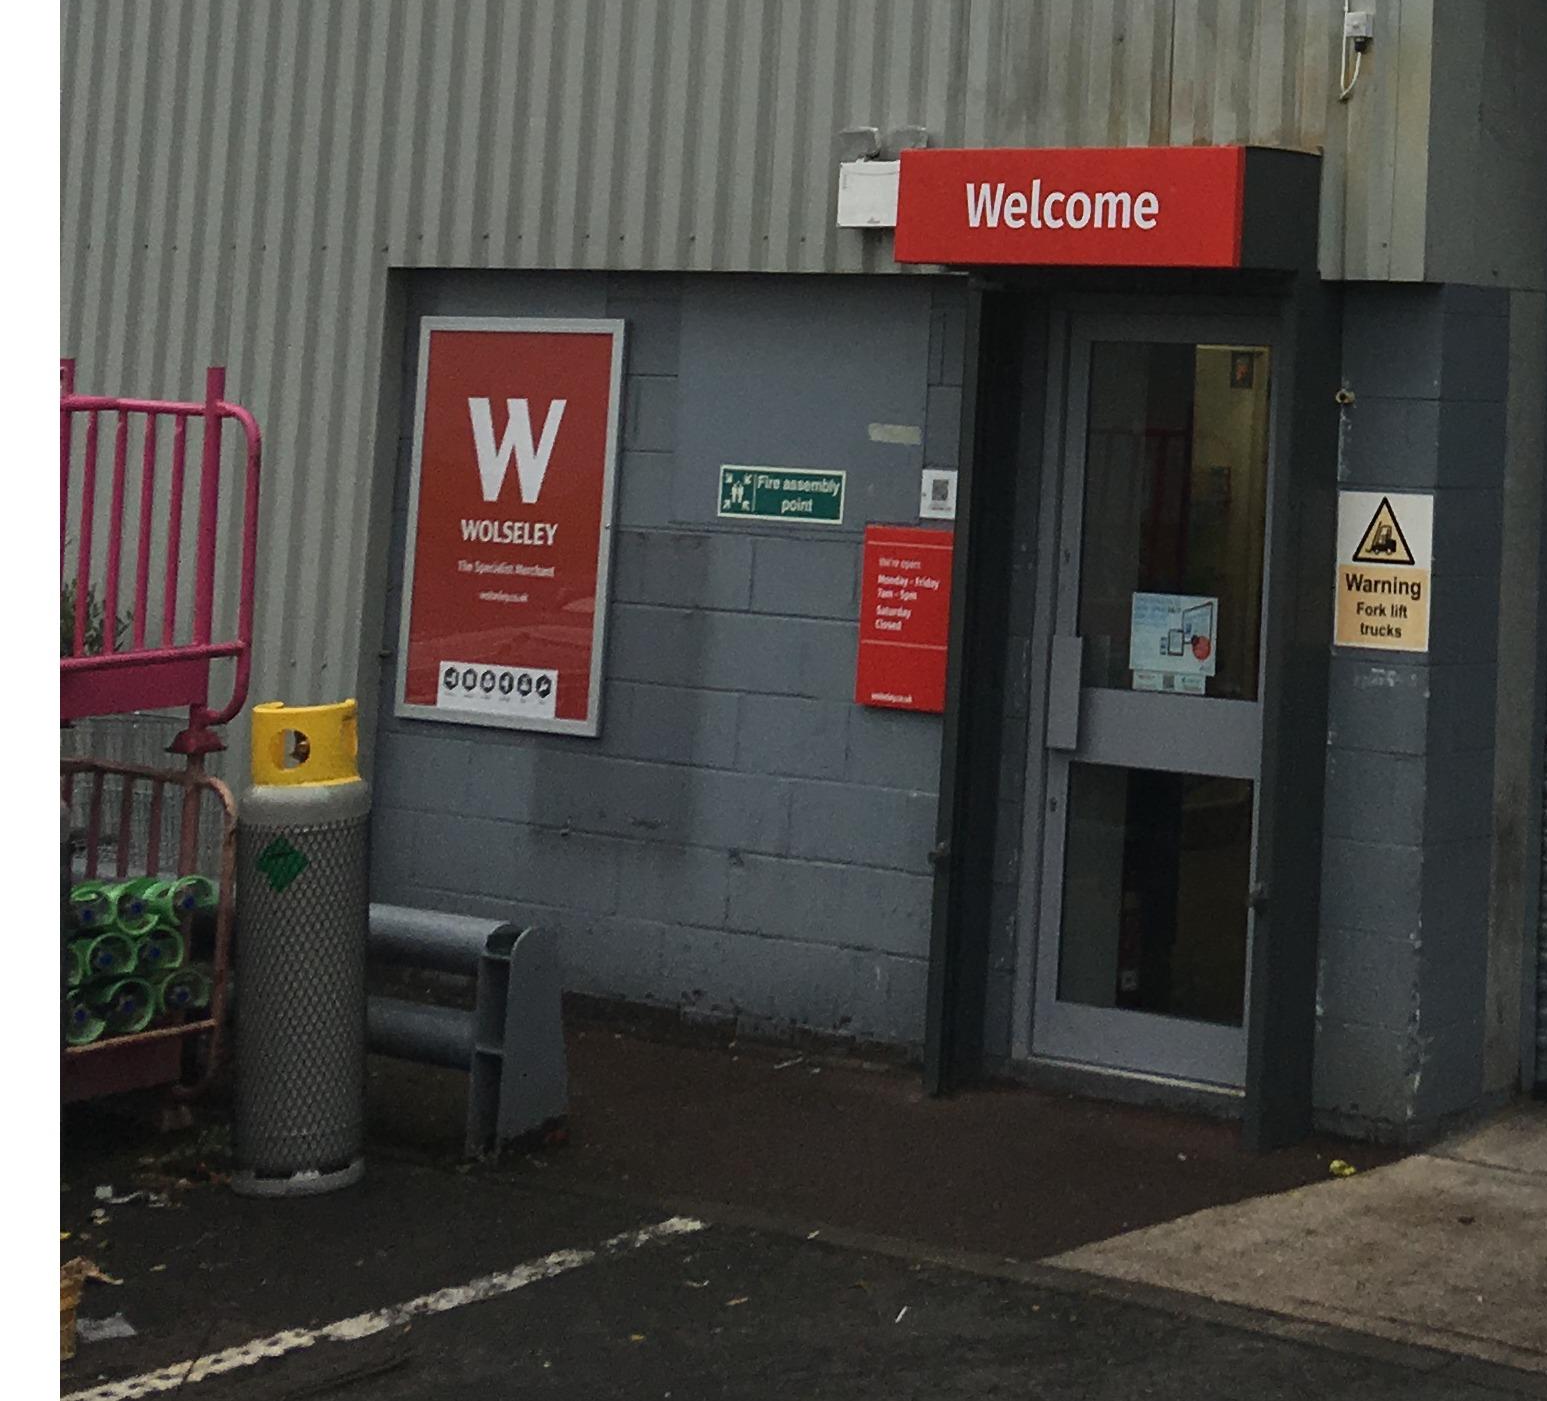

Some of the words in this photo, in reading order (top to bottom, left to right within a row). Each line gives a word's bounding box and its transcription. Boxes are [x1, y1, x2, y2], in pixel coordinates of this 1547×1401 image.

[965, 179, 1160, 230] Welcome
[467, 397, 568, 504] W
[757, 475, 780, 490] Fire
[782, 478, 840, 497] assembly
[781, 497, 813, 514] point
[460, 519, 559, 546] WOLSELEY
[458, 560, 473, 572] The
[475, 560, 514, 575] Specialist
[515, 564, 555, 578] Merchant
[878, 574, 908, 588] Monday
[915, 576, 940, 591] Friday
[1345, 573, 1421, 600] Warning
[876, 605, 912, 620] Saturday
[1356, 602, 1387, 617] Fork
[1391, 603, 1408, 619] lift
[875, 619, 902, 631] Closed
[1360, 622, 1402, 638] trucks
